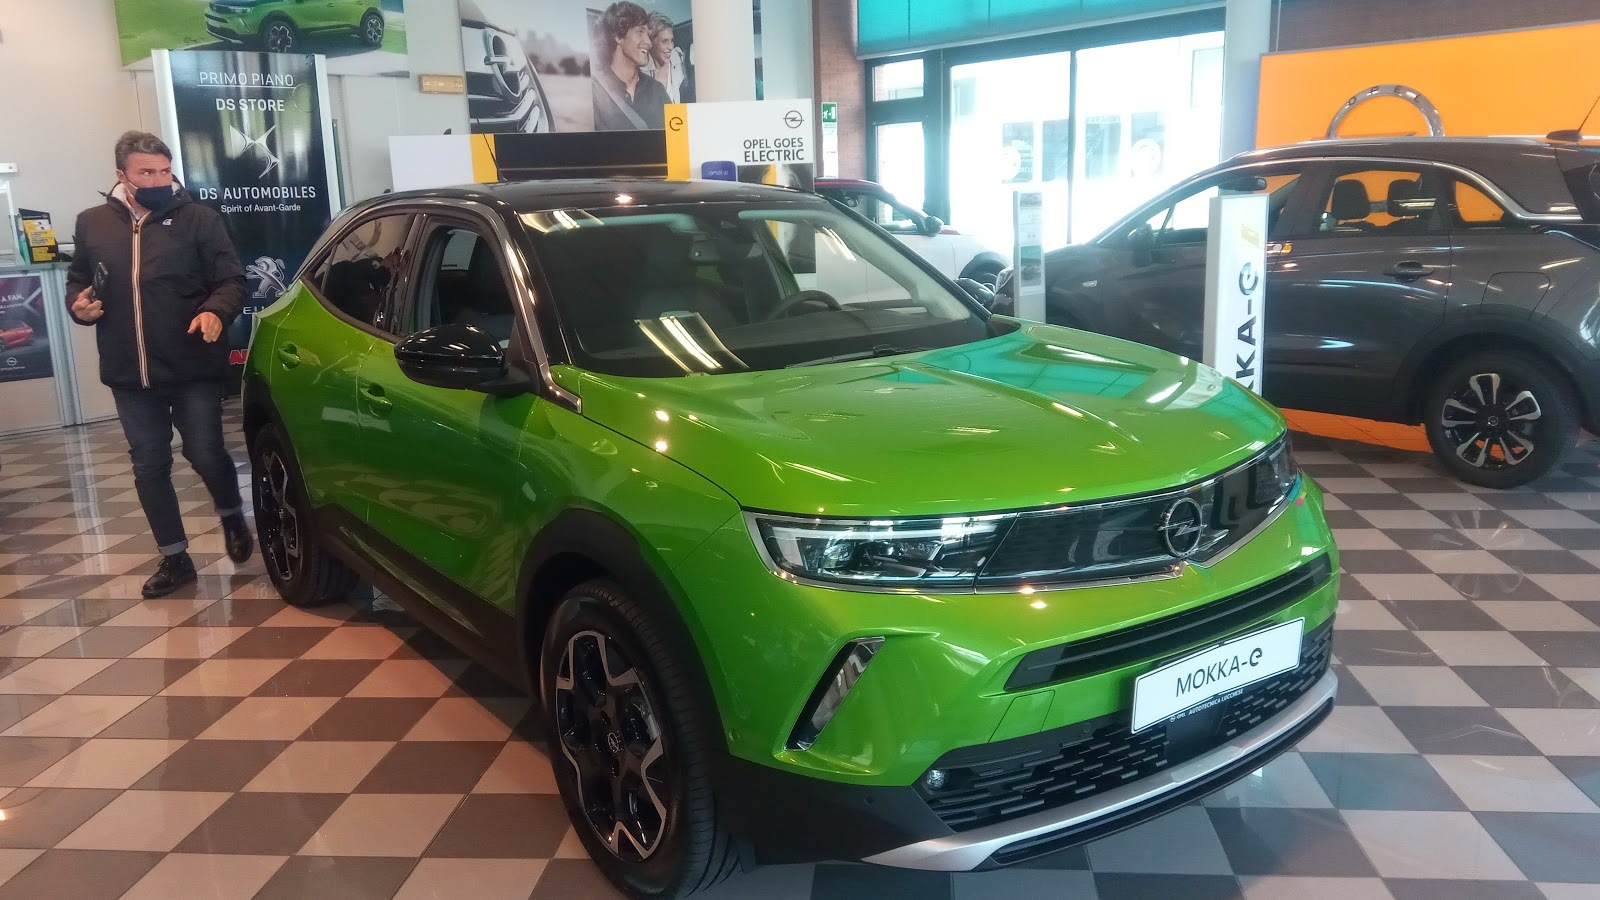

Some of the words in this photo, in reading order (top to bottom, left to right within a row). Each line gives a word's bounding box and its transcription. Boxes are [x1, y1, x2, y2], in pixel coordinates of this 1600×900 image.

[199, 71, 248, 85] PRIMO
[252, 73, 294, 87] PIANO
[1348, 84, 1422, 106] OPEL
[215, 98, 236, 111] DS
[239, 98, 285, 112] STORE
[743, 138, 771, 150] OPEL
[773, 137, 804, 149] GOES
[744, 149, 805, 163] ELECTRIC
[199, 187, 218, 200] DS
[223, 186, 316, 200] AUTOMOBILES
[221, 204, 242, 214] Spirit
[244, 204, 252, 212] of
[254, 203, 301, 212] Avant-Garde
[1175, 647, 1263, 698] MOKKA-e
[1188, 698, 1221, 716] AUTOTECNICA
[1221, 688, 1244, 702] LUCCHESE
